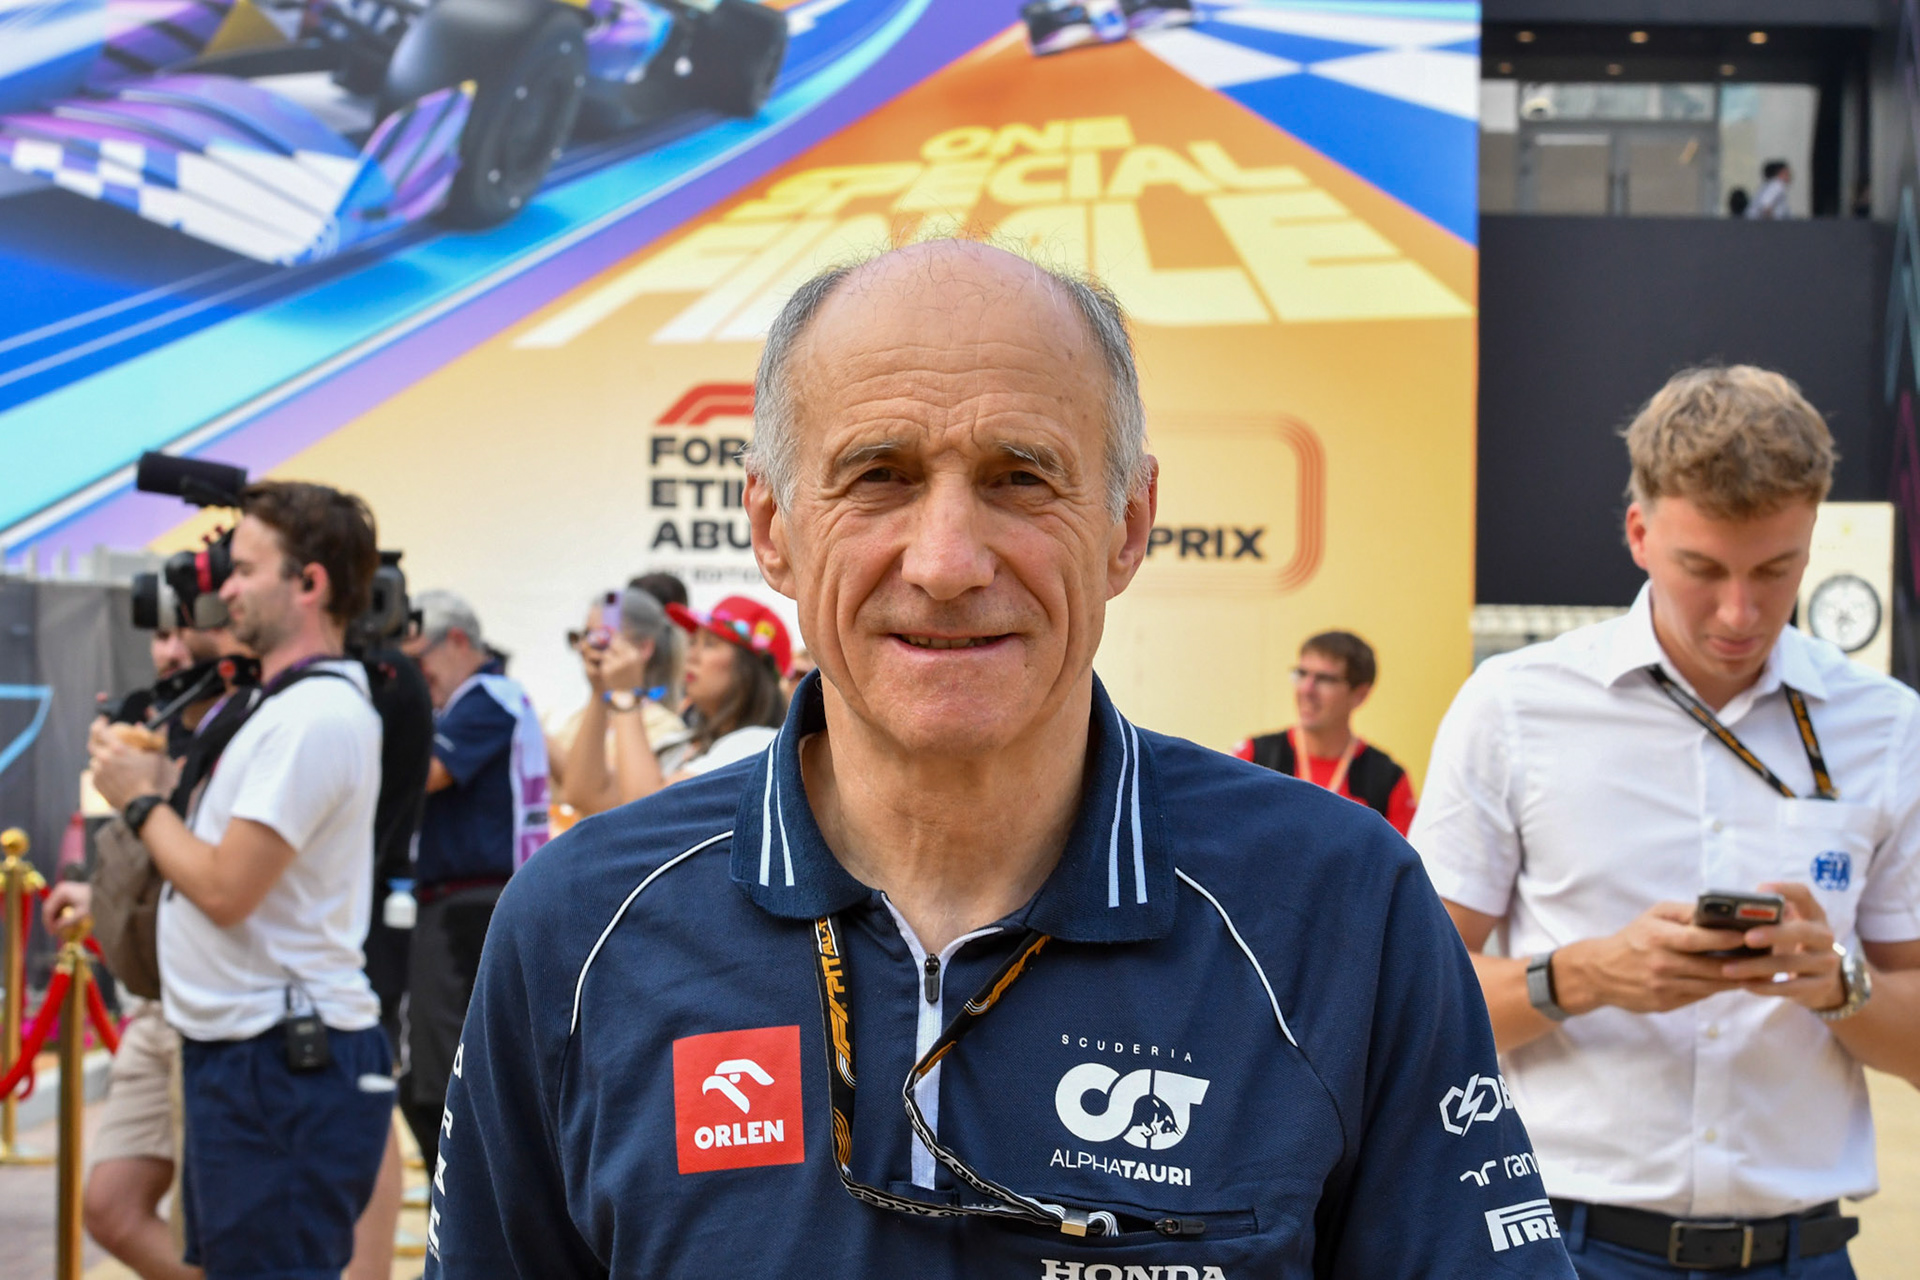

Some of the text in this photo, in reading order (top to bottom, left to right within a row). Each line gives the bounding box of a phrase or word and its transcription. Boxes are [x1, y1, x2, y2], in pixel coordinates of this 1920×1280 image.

[920, 115, 1136, 161] ONE
[723, 138, 1309, 222] SPECIAL
[652, 520, 1264, 558] ABU PRIX
[1060, 1033, 1194, 1064] SCUDERIA
[694, 1119, 785, 1150] ORLEN
[1049, 1148, 1193, 1187] ALPHATAURI
[1040, 1259, 1228, 1280] HONDA
